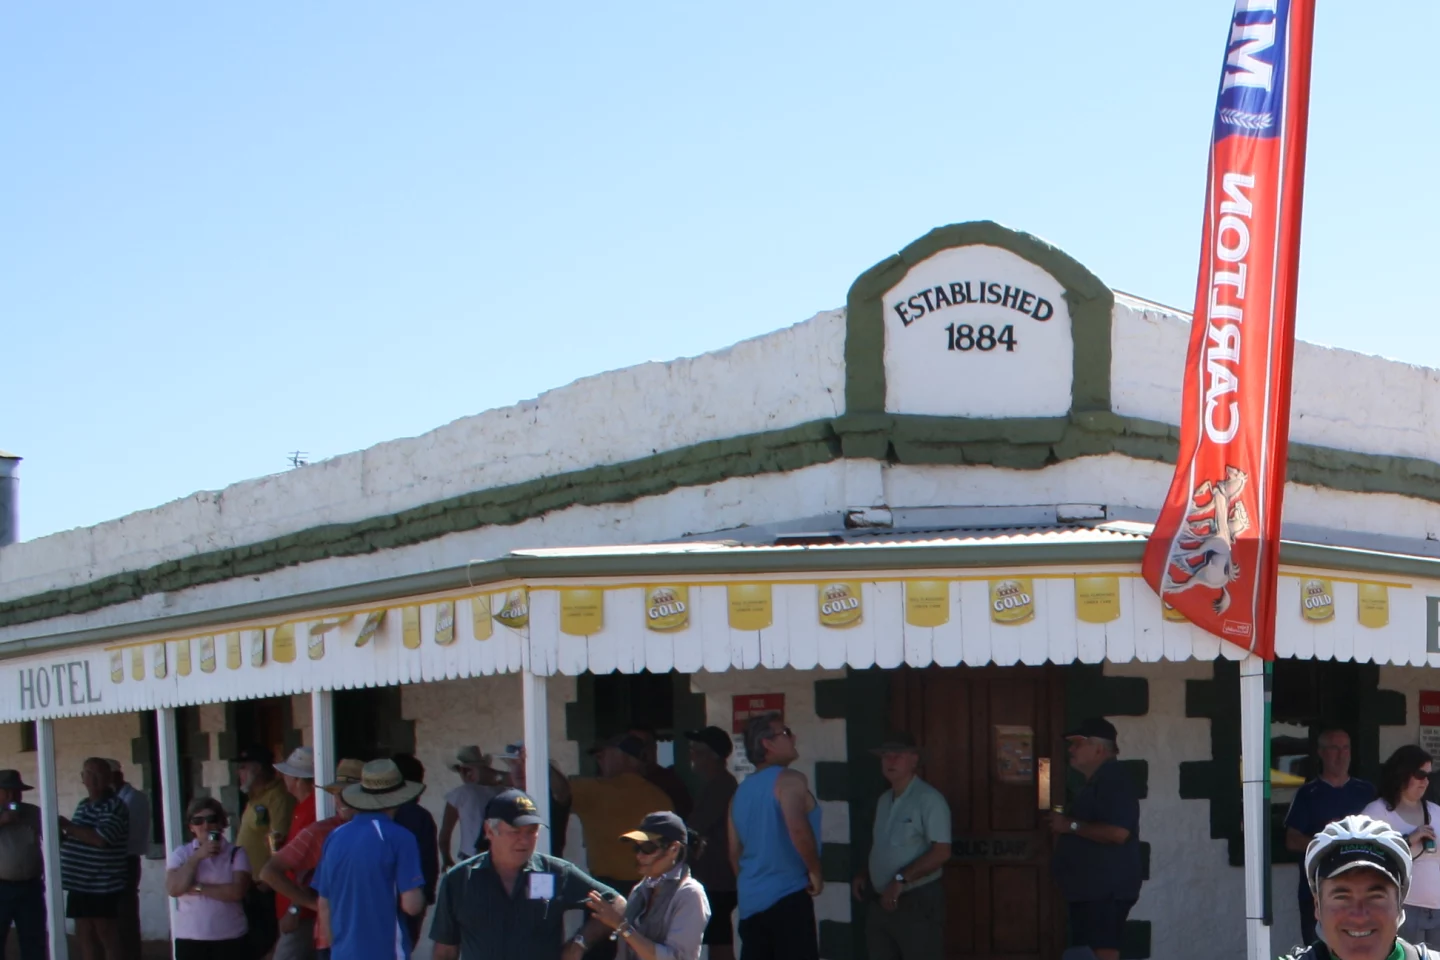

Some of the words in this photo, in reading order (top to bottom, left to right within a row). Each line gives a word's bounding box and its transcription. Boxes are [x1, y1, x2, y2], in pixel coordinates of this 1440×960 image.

[893, 281, 1055, 328] ESTABLISHED
[945, 323, 1018, 352] 1884
[826, 590, 848, 600] XXXX
[998, 587, 1019, 597] XXXX
[501, 604, 527, 619] GOLD
[649, 601, 686, 620] GOLD
[821, 596, 859, 616] GOLD
[993, 592, 1031, 613] GOLD
[1304, 594, 1332, 610] GOLD
[19, 660, 102, 710] HOTEL
